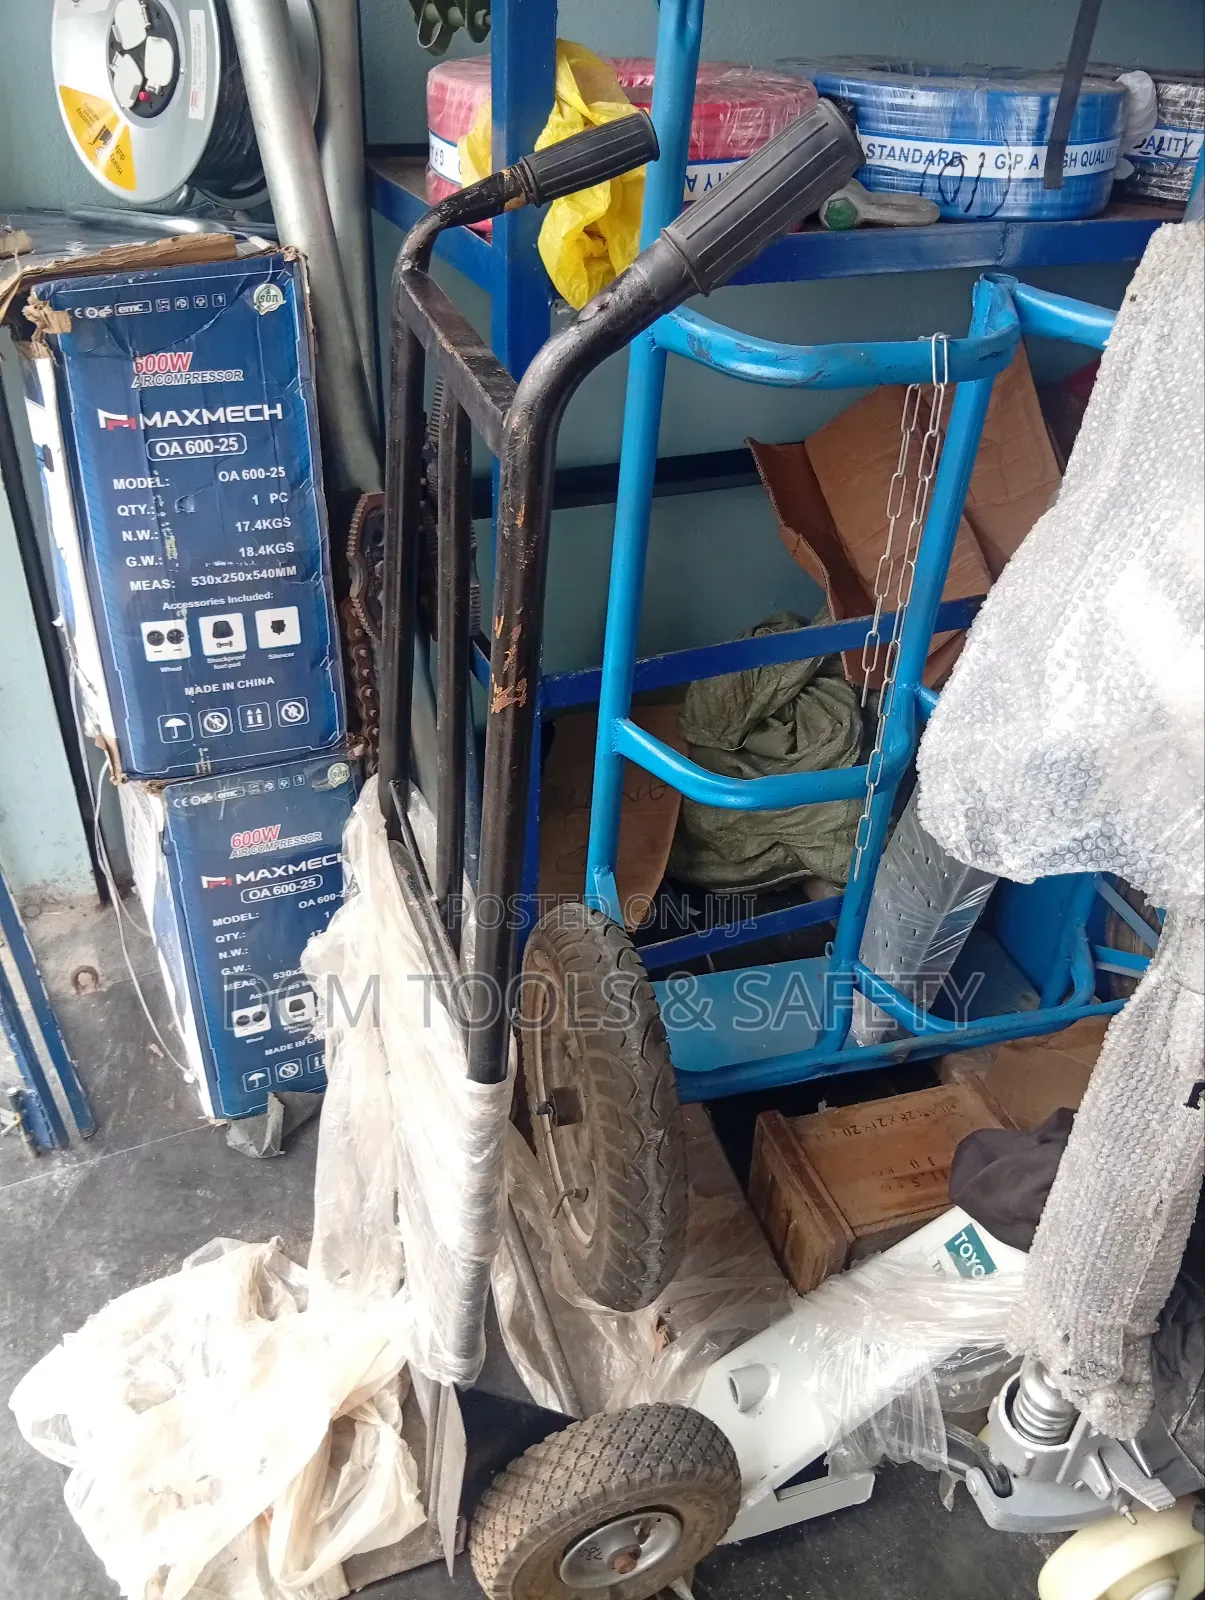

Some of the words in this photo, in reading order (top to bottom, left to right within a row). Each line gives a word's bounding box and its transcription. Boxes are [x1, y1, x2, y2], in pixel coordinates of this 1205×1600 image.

[866, 143, 961, 168] STANDARD
[133, 351, 193, 374] 600W
[154, 369, 244, 386] COMPRESSOR
[139, 403, 283, 430] MAXMECH
[155, 443, 183, 457] OA
[185, 437, 239, 454] 600-25
[113, 477, 170, 490] MODEL:
[218, 470, 239, 483] OA
[242, 467, 286, 481] 600-25
[252, 495, 259, 506] 1
[269, 493, 290, 505] PC
[235, 516, 292, 533] 17.4KGS
[238, 541, 295, 559] 18.4KGS
[130, 579, 175, 591] MEAS:
[191, 565, 297, 587] 530x250x540MM
[162, 597, 226, 611] Accessories
[184, 684, 221, 696] MADE
[222, 681, 235, 692] IN
[236, 675, 275, 690] CHINA
[231, 824, 281, 848] 600W
[251, 831, 323, 855] COMPRESSOR
[248, 889, 272, 900] OA
[272, 878, 317, 895] 600-25
[212, 912, 260, 927] MODEL:
[298, 898, 316, 909] OA
[223, 978, 261, 992] MEAS:
[264, 1042, 294, 1056] MADE
